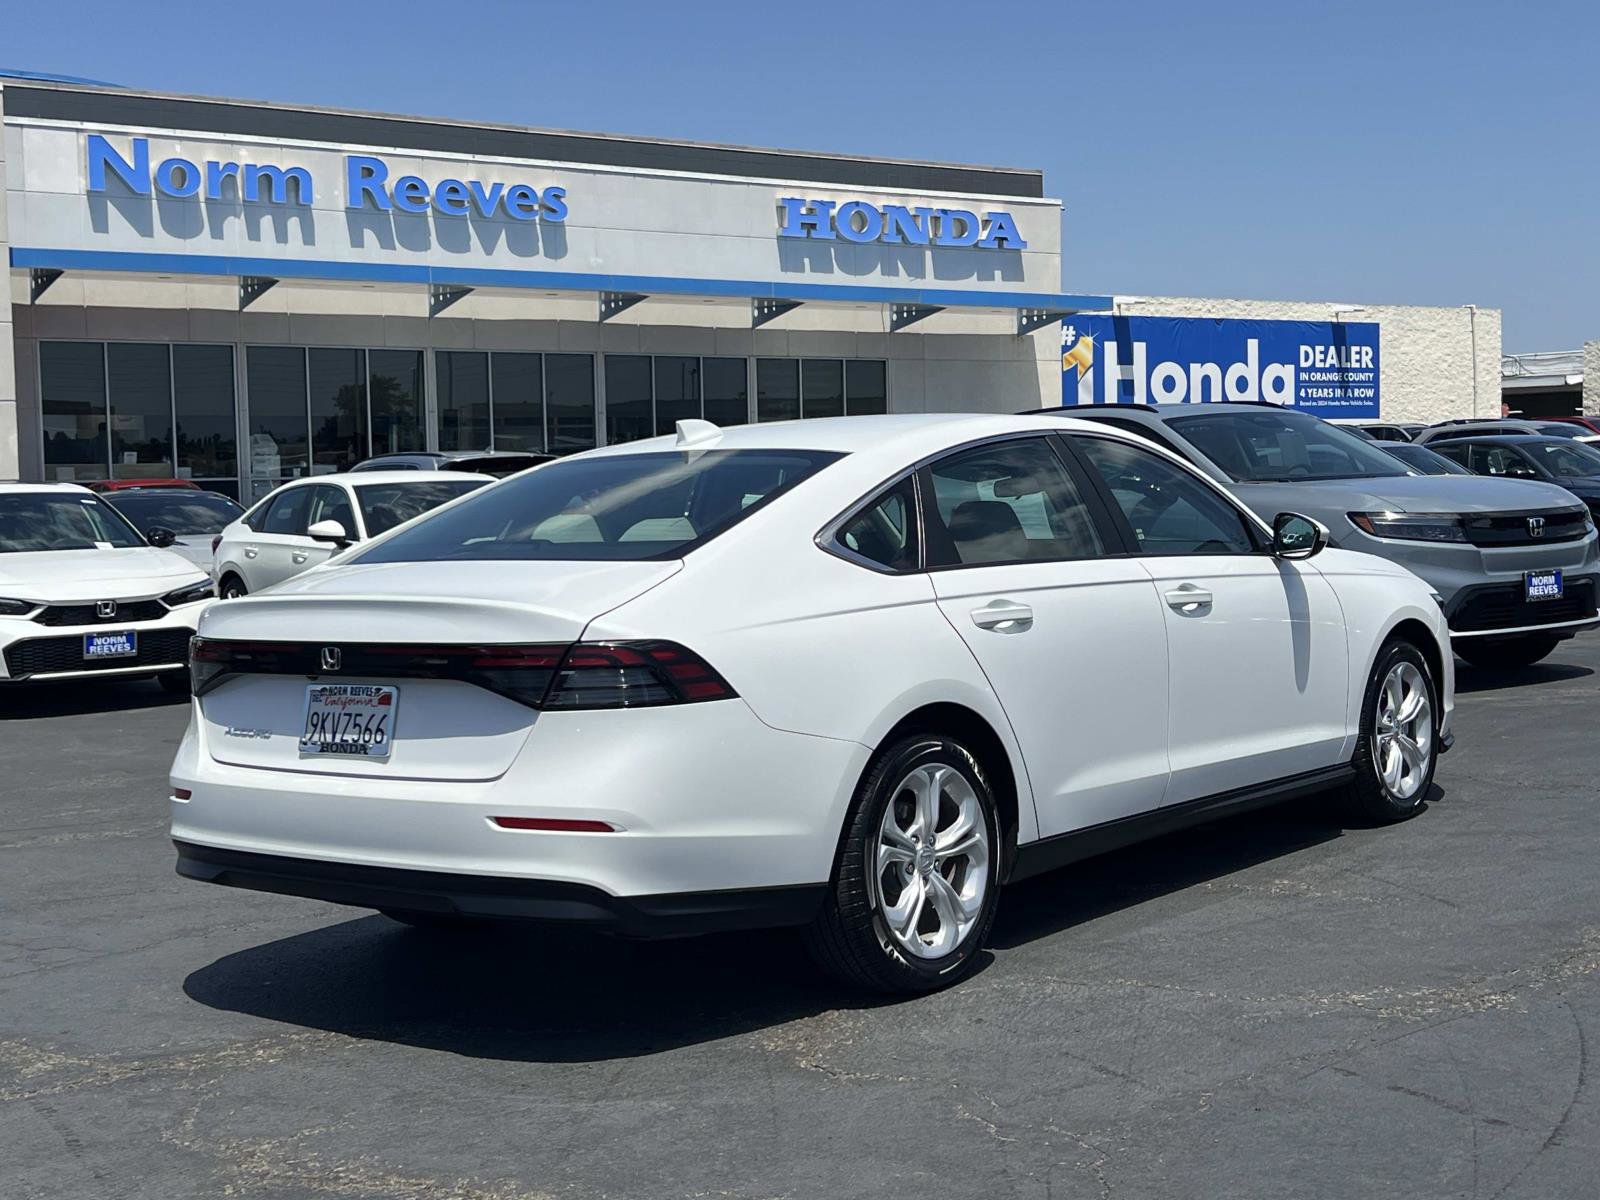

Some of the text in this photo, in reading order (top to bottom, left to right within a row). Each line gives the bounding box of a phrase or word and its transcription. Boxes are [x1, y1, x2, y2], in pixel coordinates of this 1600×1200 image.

[86, 134, 568, 222] Norm Reeves
[779, 197, 1028, 249] HONDA
[1300, 345, 1374, 368] DEALER
[1104, 338, 1295, 405] Honda
[1300, 372, 1374, 381] IN ORANGE COUNTY
[1300, 388, 1375, 397] 4 YEARS IN A ROW
[1531, 575, 1555, 586] NORM
[1529, 584, 1558, 595] REEVES
[93, 635, 127, 646] NORM
[89, 643, 131, 654] REEVES
[328, 686, 374, 697] NORM REEVES
[308, 711, 388, 745] 9KVZ566
[319, 742, 369, 755] HONDA
